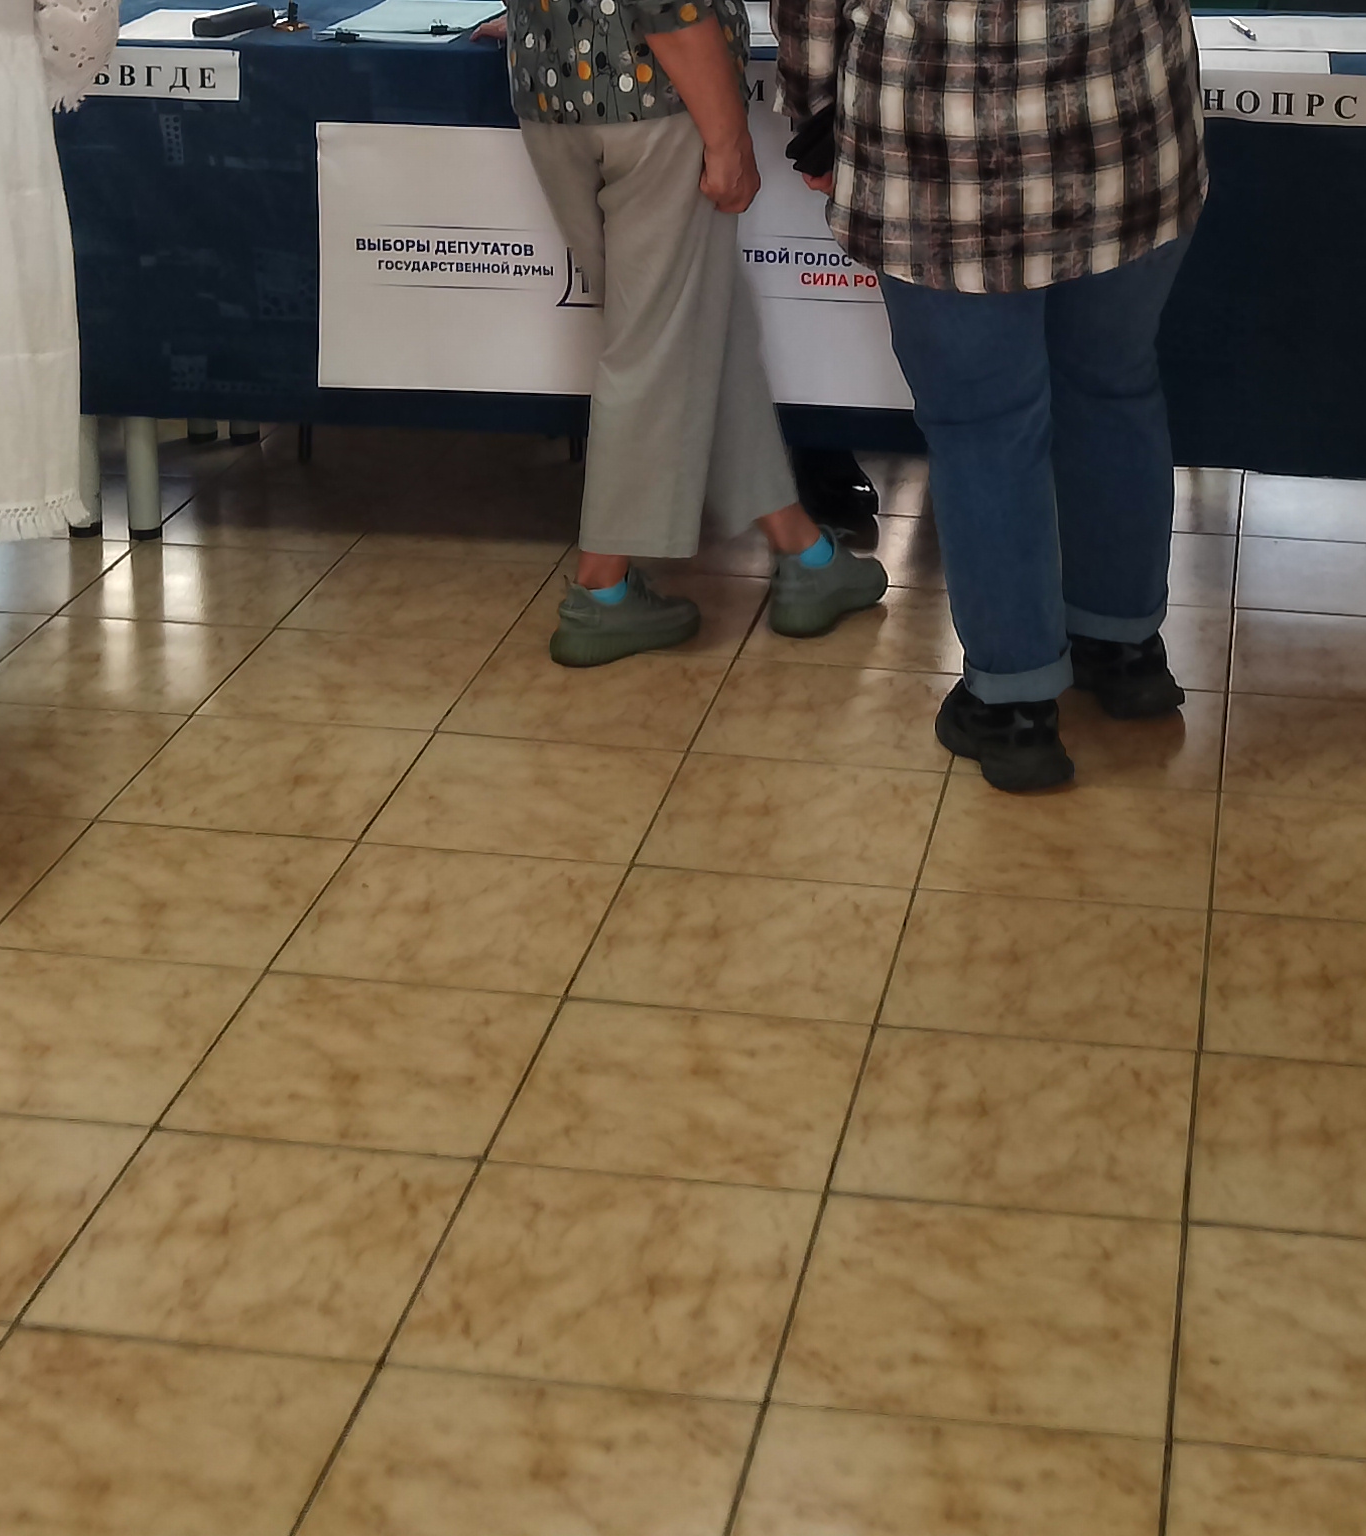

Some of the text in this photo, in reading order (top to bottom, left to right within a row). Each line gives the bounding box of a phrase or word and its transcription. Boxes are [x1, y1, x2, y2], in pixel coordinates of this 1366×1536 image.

[355, 238, 535, 257] ВЫБОРЫ ДЕПУТАТОВ
[742, 247, 790, 264] ТВОЙ
[378, 259, 554, 277] ГОСУДАРСТВЕННОЙ ДУМЫ
[800, 272, 877, 288] СИЛА РО
